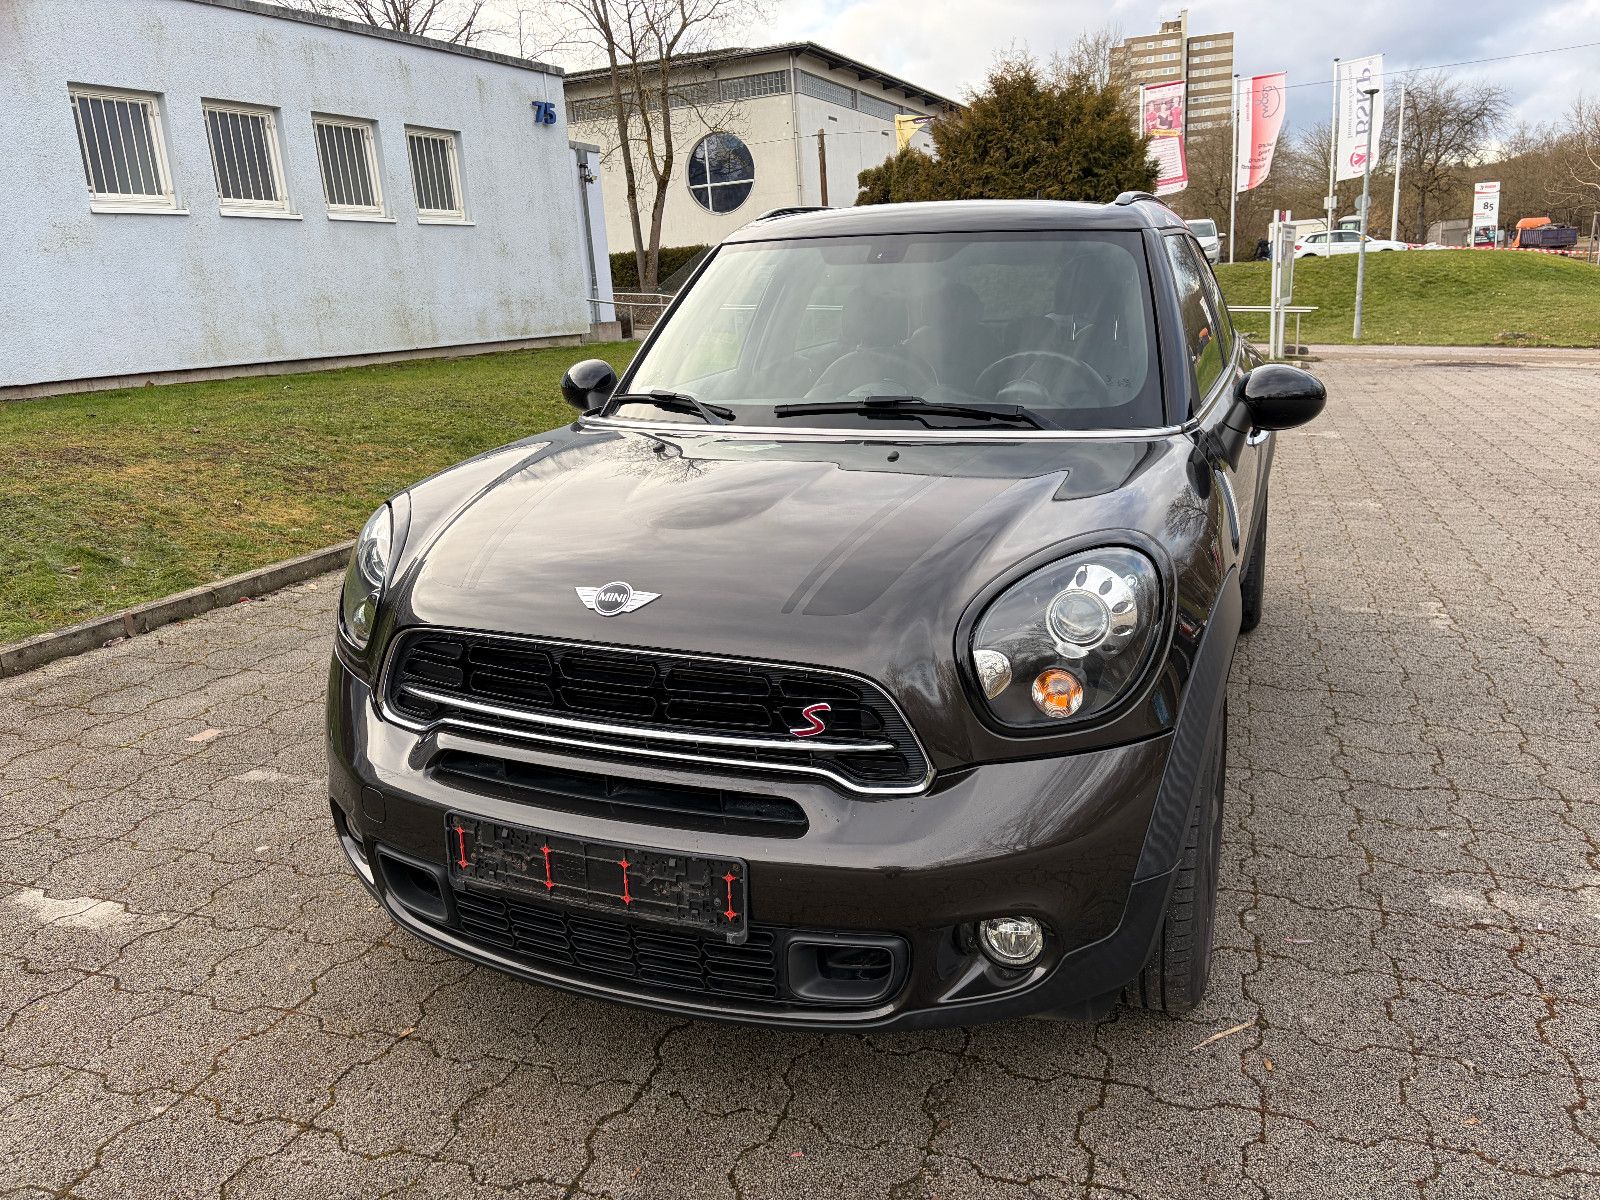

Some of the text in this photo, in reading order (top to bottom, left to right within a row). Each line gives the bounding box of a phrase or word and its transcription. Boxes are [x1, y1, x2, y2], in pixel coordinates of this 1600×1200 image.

[531, 101, 557, 125] 75
[1483, 201, 1494, 212] 85
[599, 592, 628, 603] MINI
[789, 702, 832, 737] S
